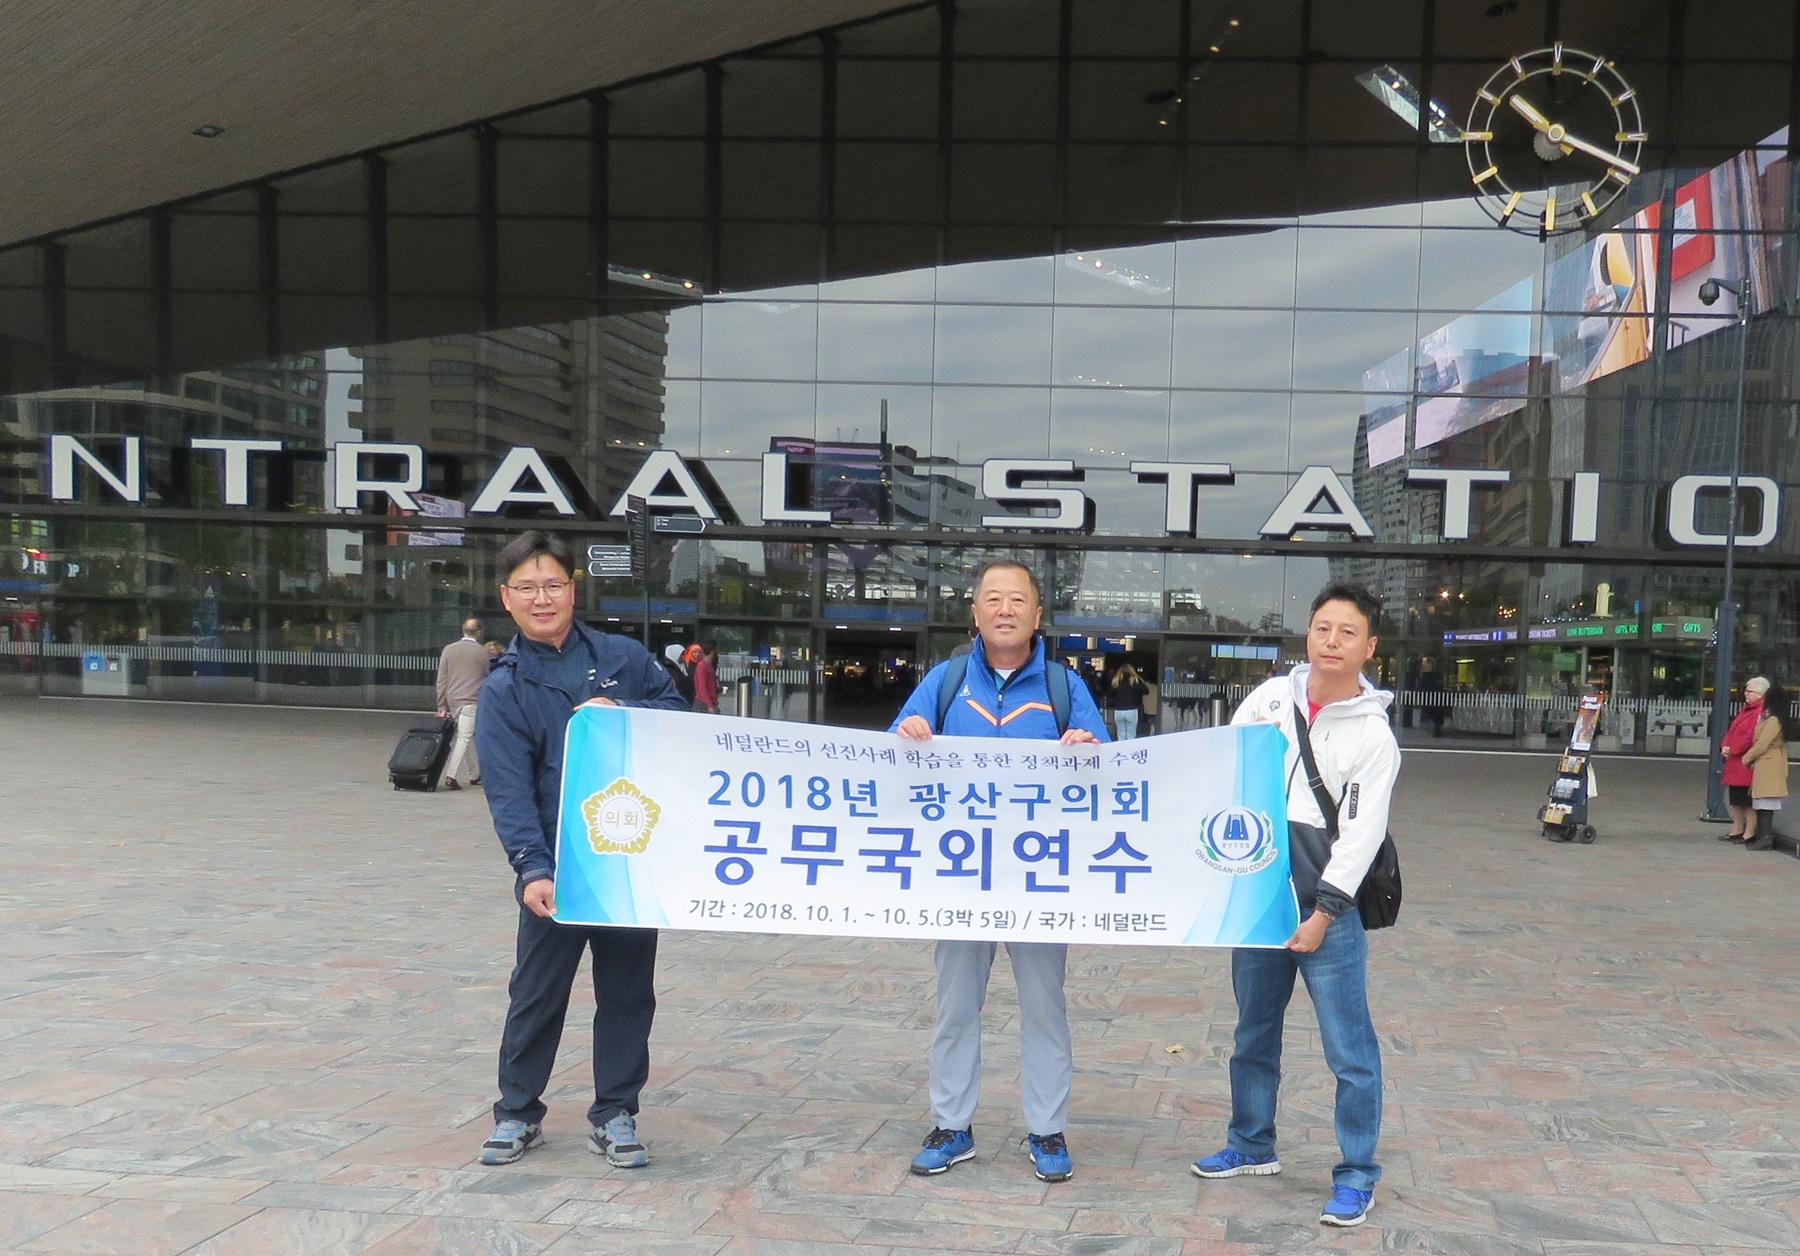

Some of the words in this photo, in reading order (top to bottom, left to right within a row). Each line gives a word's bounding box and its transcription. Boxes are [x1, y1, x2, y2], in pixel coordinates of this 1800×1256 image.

[980, 458, 1781, 548] STATIO
[1683, 623, 1702, 633] GIFTS
[715, 732, 812, 758] 네덜란드의
[819, 742, 897, 766] 선진사례
[904, 750, 965, 770] 학습을
[971, 752, 1013, 769] 통한
[1020, 754, 1101, 772] 정책과제
[1109, 749, 1148, 767] 수행
[707, 770, 879, 818] 2018년
[908, 780, 1149, 822] 광산구의회
[605, 809, 639, 830] 의회
[703, 819, 1153, 895] 공무국외연수
[1194, 848, 1249, 875] GWANGSAN-GU
[1249, 849, 1277, 870] COUNCIL
[688, 899, 726, 919] 기간
[743, 902, 798, 922] 2018.
[805, 905, 834, 923] 10.
[842, 906, 858, 923] 1.
[883, 908, 911, 926] 10.
[980, 909, 1017, 930] 5일)
[1038, 911, 1076, 931] 국가
[1094, 911, 1168, 933] 네덜란드
